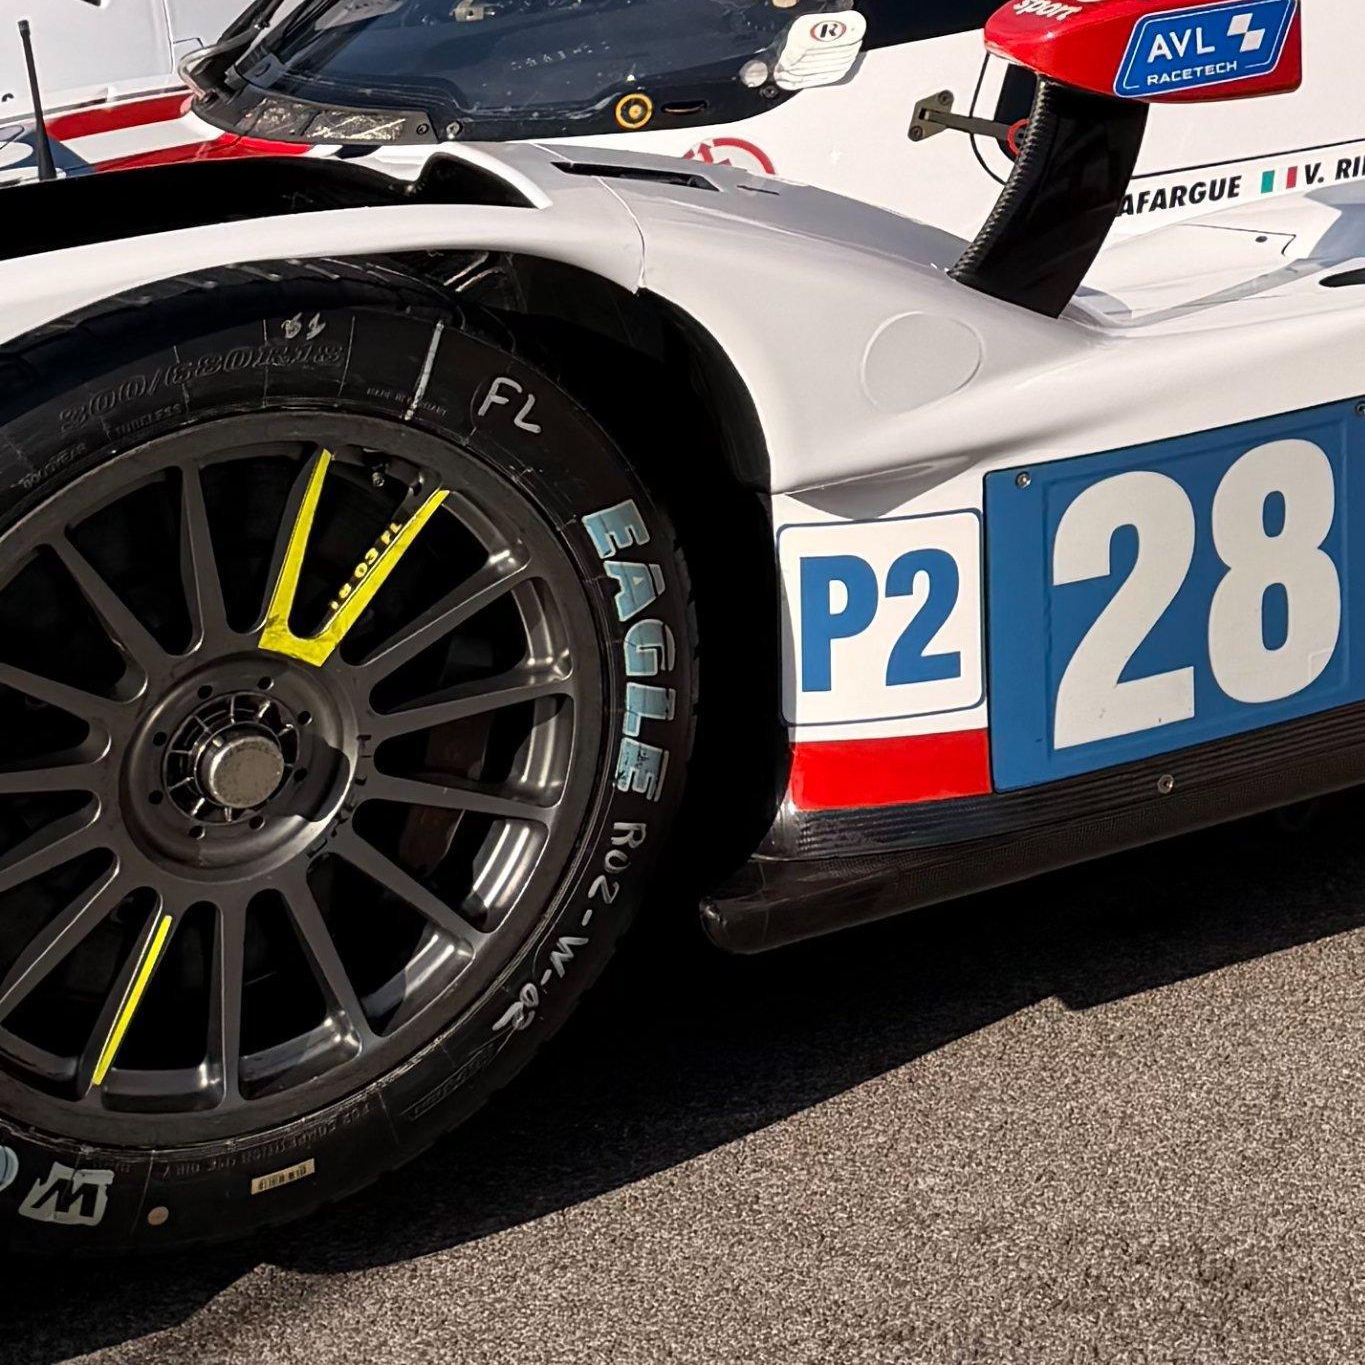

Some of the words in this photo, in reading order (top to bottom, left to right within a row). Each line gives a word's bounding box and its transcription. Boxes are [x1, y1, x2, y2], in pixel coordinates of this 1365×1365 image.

[1147, 27, 1216, 64] AVL
[1147, 60, 1238, 86] RACETECH
[1118, 174, 1242, 217] AFARGUE
[1303, 162, 1324, 186] V.
[477, 375, 542, 435] FL
[799, 547, 962, 693] P2
[1052, 438, 1343, 751] 28
[581, 498, 677, 804] EAGLE
